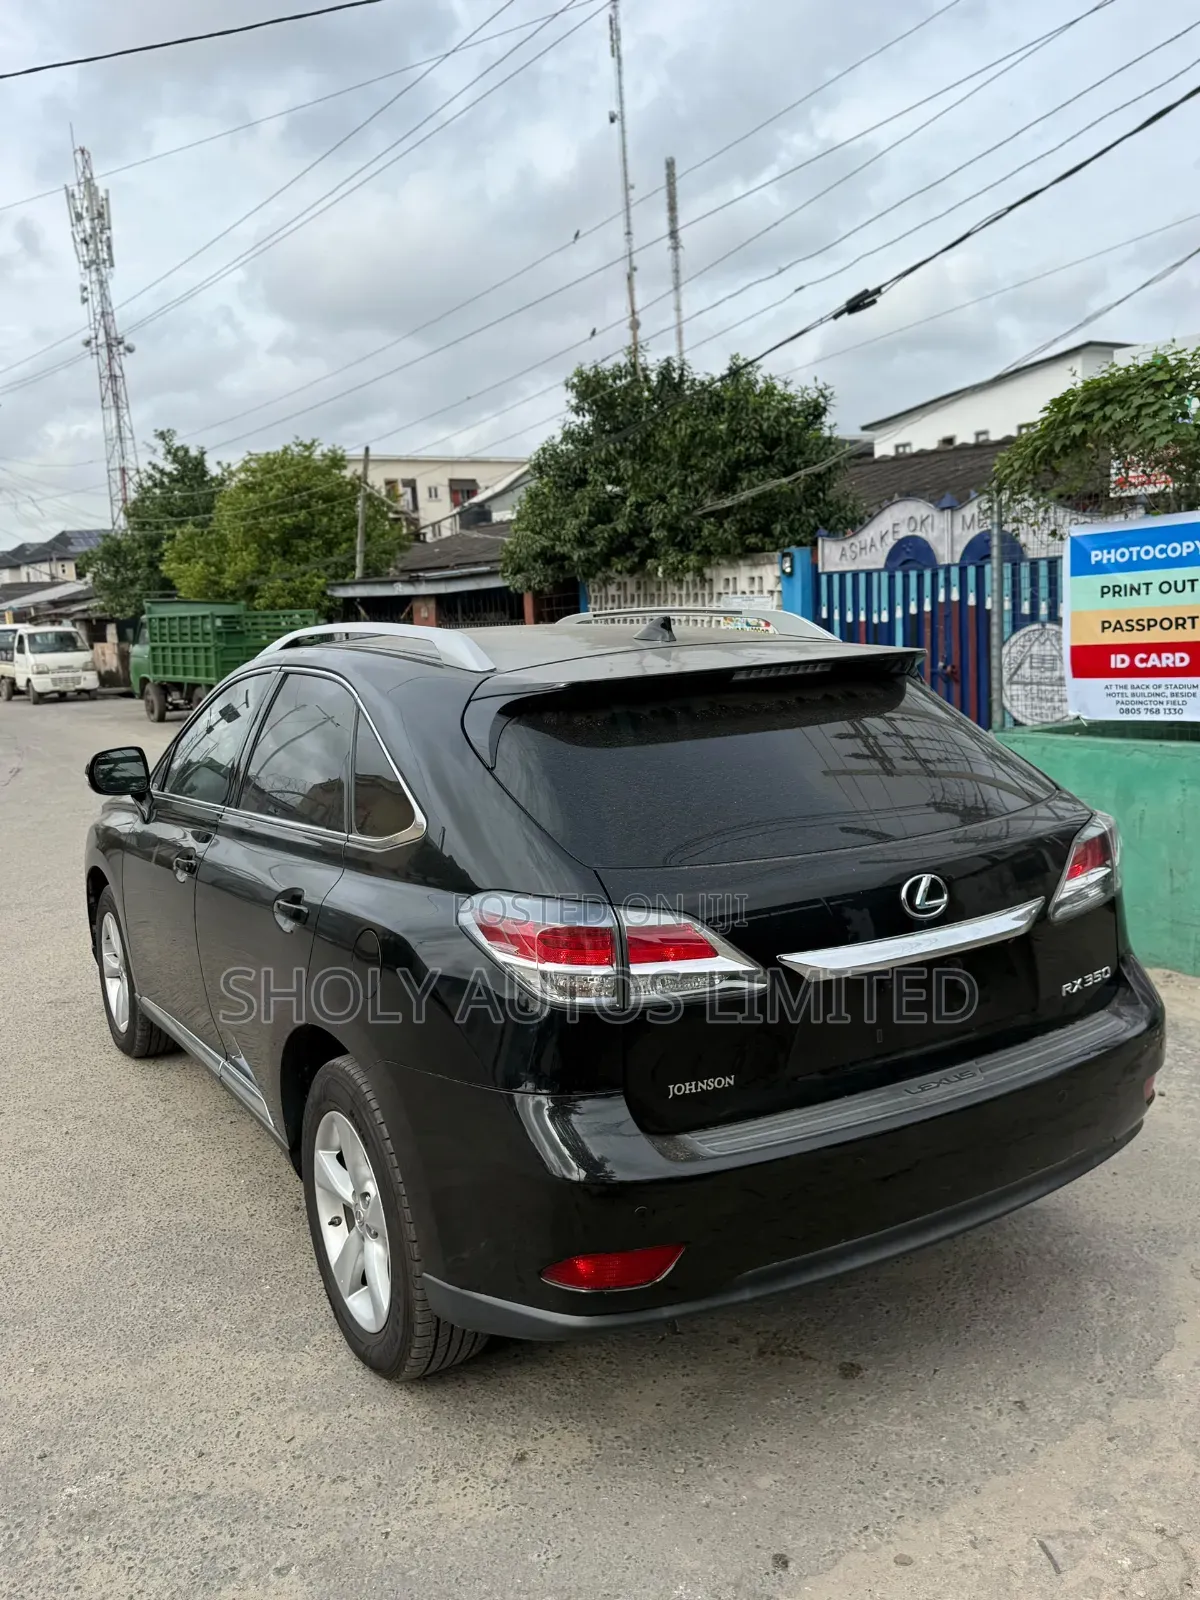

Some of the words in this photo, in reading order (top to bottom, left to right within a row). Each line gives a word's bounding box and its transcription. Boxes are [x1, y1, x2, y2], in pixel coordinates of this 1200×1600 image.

[838, 522, 901, 561] ASHAKE
[907, 514, 934, 533] OKI
[1100, 582, 1153, 598] PRINT
[1158, 578, 1199, 595] OUT
[1101, 615, 1199, 633] PASSPORT
[1110, 653, 1130, 669] ID
[1134, 651, 1190, 668] CARD
[1062, 978, 1083, 997] RX
[1084, 965, 1111, 987] 350
[668, 1075, 735, 1099] JOHNSON
[903, 1070, 976, 1095] LEXUS
